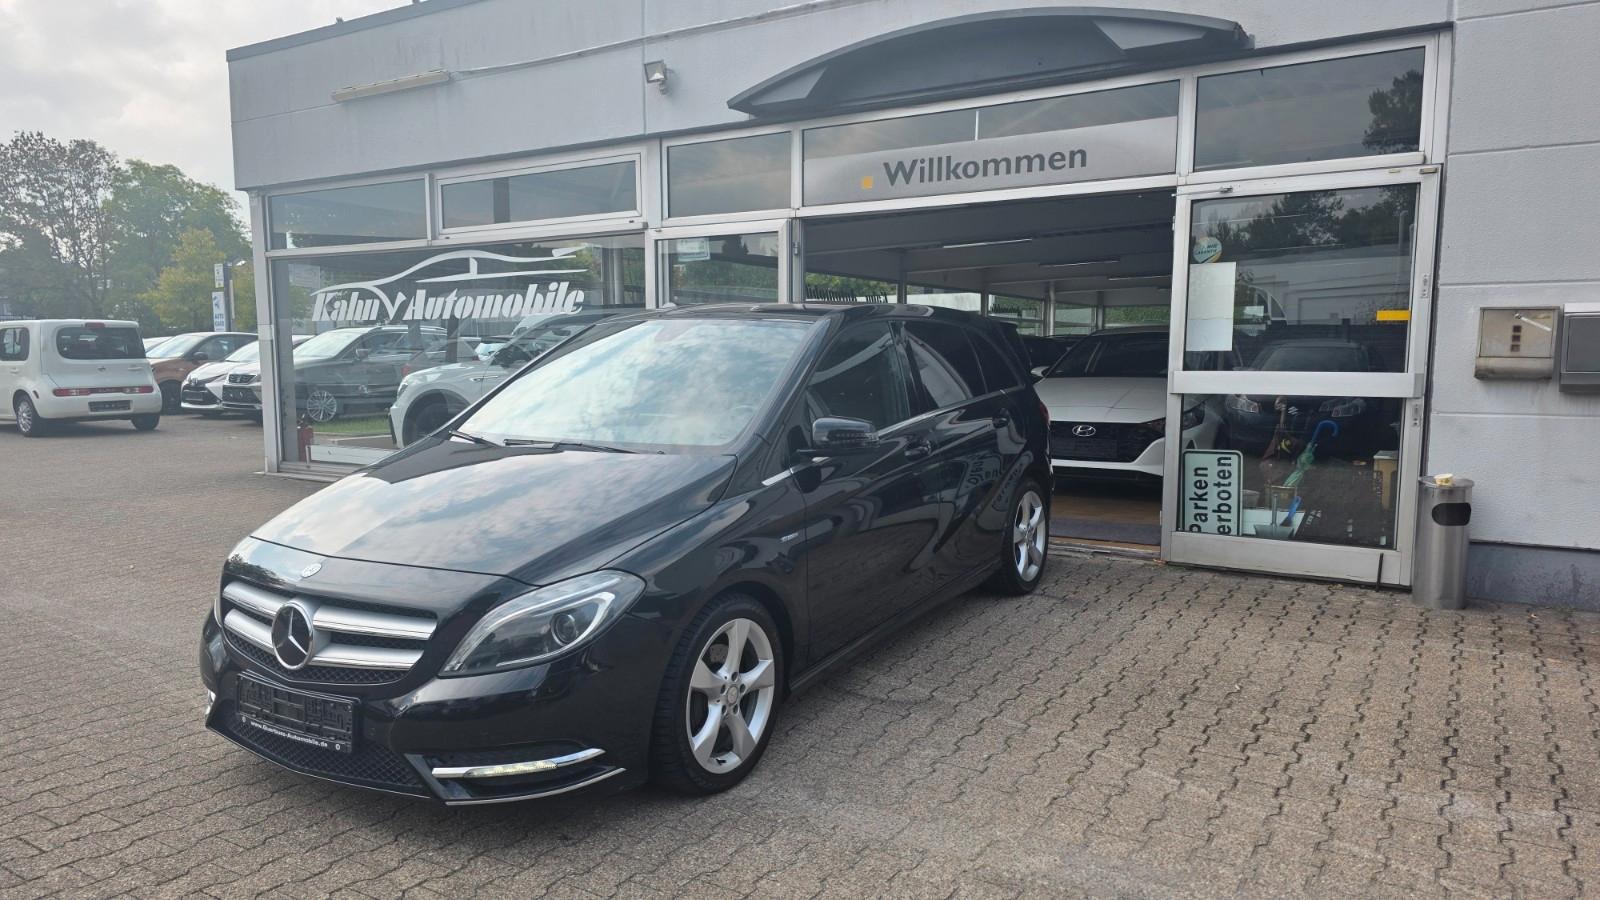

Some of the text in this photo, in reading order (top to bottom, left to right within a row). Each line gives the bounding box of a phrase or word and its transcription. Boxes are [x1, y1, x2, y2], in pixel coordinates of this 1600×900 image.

[883, 148, 1087, 187] Willkommen
[311, 281, 585, 322] Kahn Automobile
[1189, 466, 1209, 533] Parken
[1212, 456, 1232, 535] erboten
